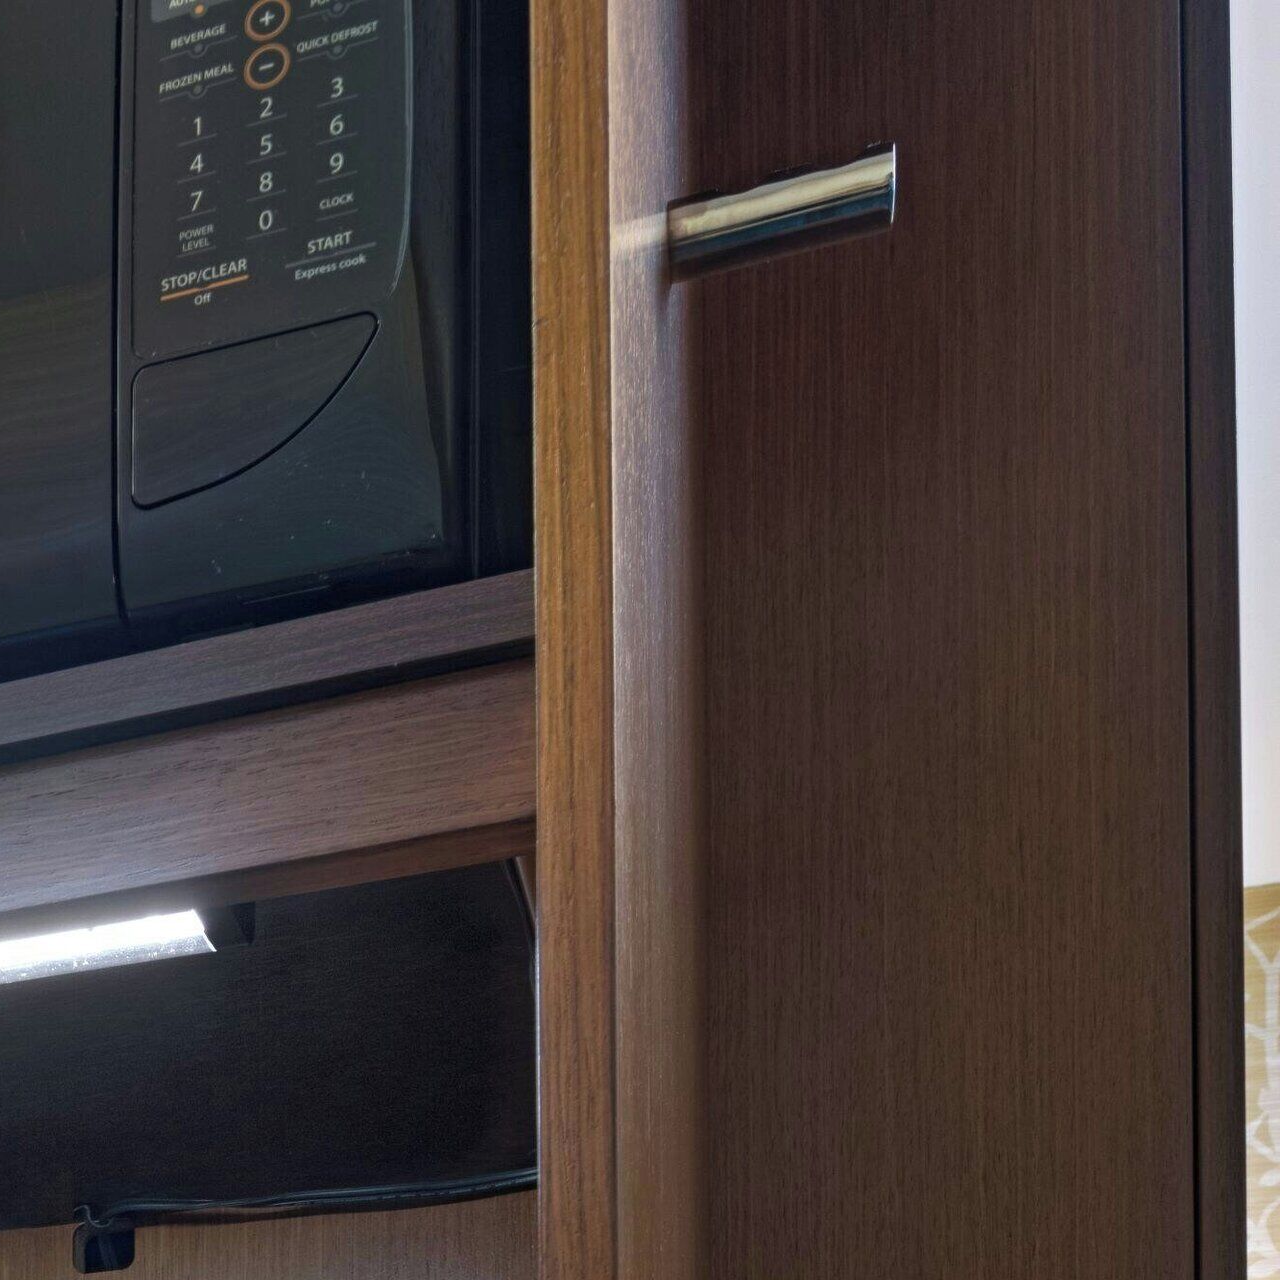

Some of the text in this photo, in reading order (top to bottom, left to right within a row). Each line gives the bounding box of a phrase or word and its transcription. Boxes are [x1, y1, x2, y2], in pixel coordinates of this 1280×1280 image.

[170, 24, 226, 49] BEVERAGE
[296, 20, 379, 54] QUICK DEFROST
[159, 62, 234, 94] FROZEN MEAL
[330, 77, 344, 98] 3
[259, 97, 273, 118] 2
[192, 116, 202, 136] 1
[329, 114, 344, 135] 6
[259, 134, 273, 156] 5
[190, 153, 204, 173] 4
[329, 153, 344, 173] 9
[259, 172, 273, 193] 8
[190, 190, 203, 212] 7
[319, 192, 354, 210] CLOCK
[259, 210, 273, 230] 0
[179, 223, 214, 241] POWER
[307, 230, 353, 254] START
[182, 237, 210, 252] LEVEL
[161, 258, 249, 292] STOP/CLEAR
[294, 252, 367, 281] Express cook
[193, 292, 212, 306] Off
